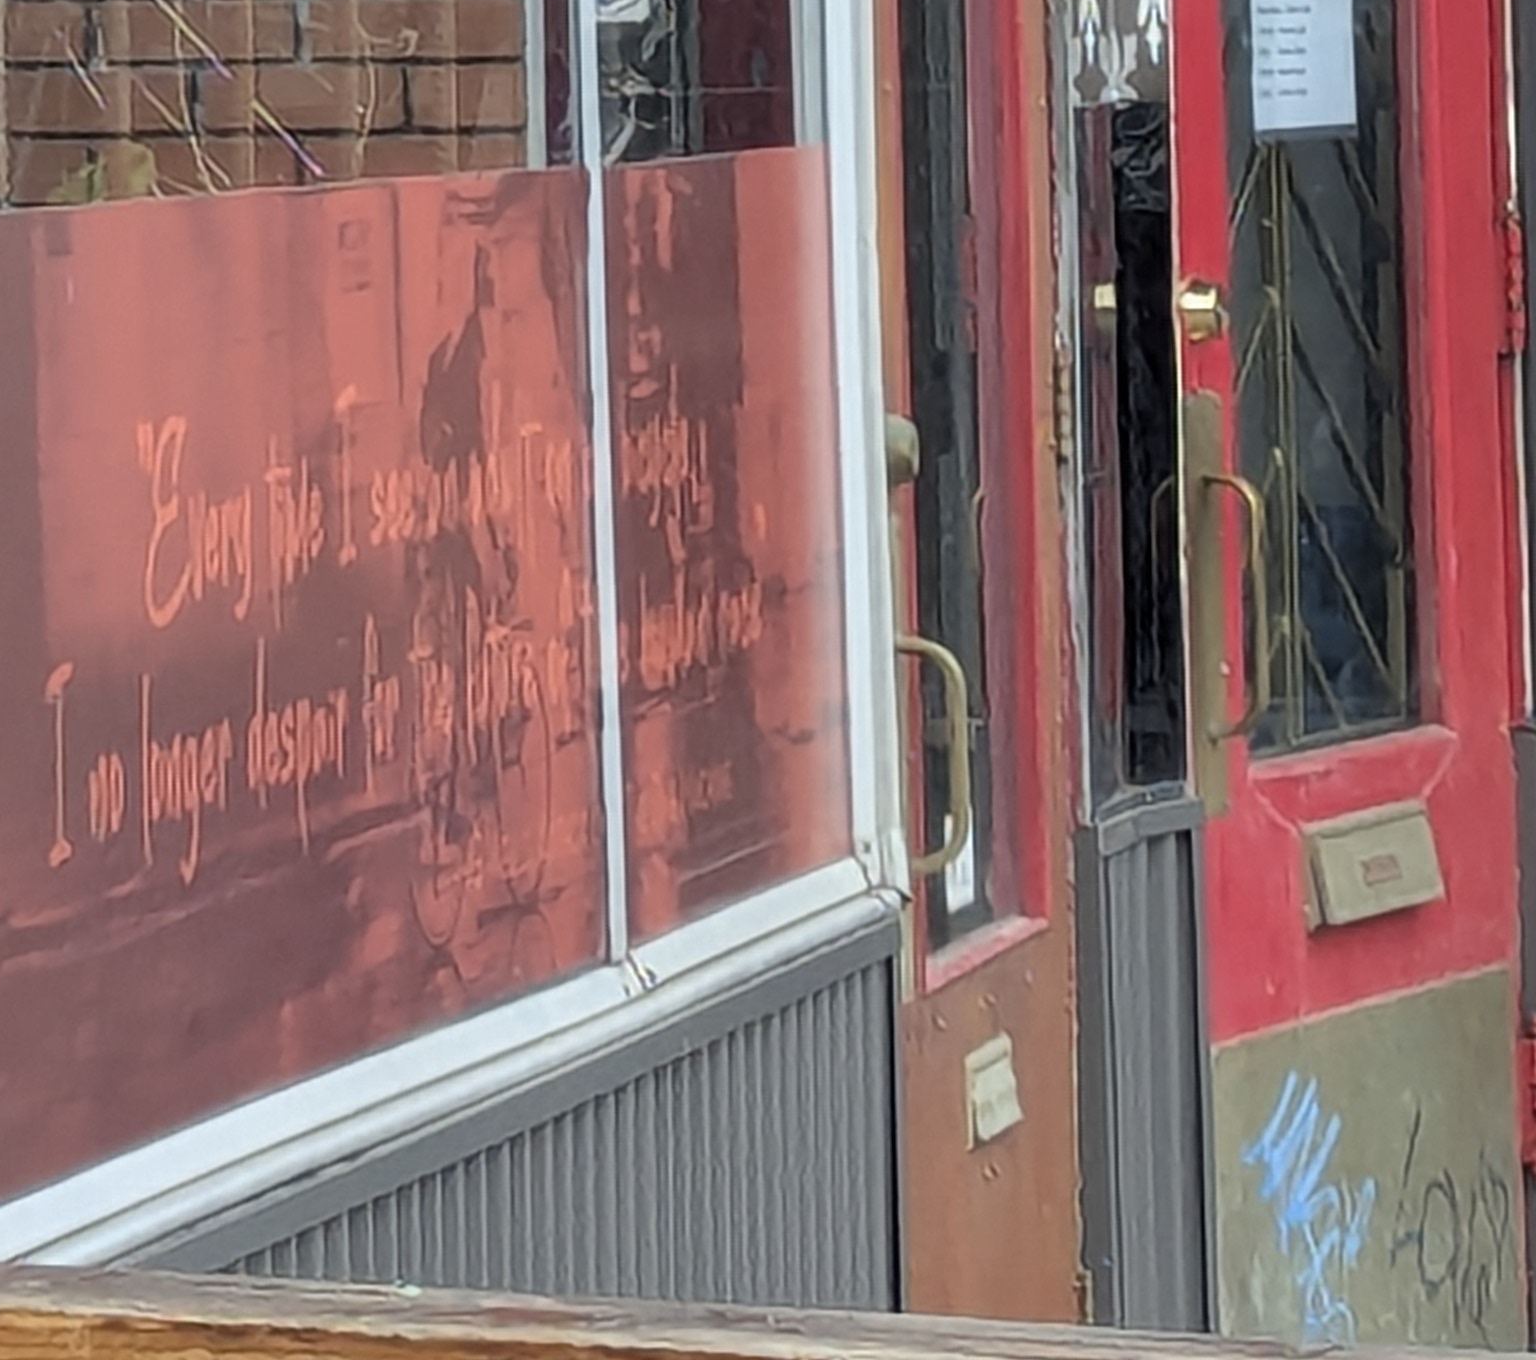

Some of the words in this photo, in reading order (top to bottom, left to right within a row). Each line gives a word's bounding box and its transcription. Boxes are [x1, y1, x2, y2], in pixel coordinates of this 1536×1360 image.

[45, 661, 75, 868] I
[88, 751, 125, 844] no
[140, 672, 233, 886] longer
[247, 636, 347, 857] despair
